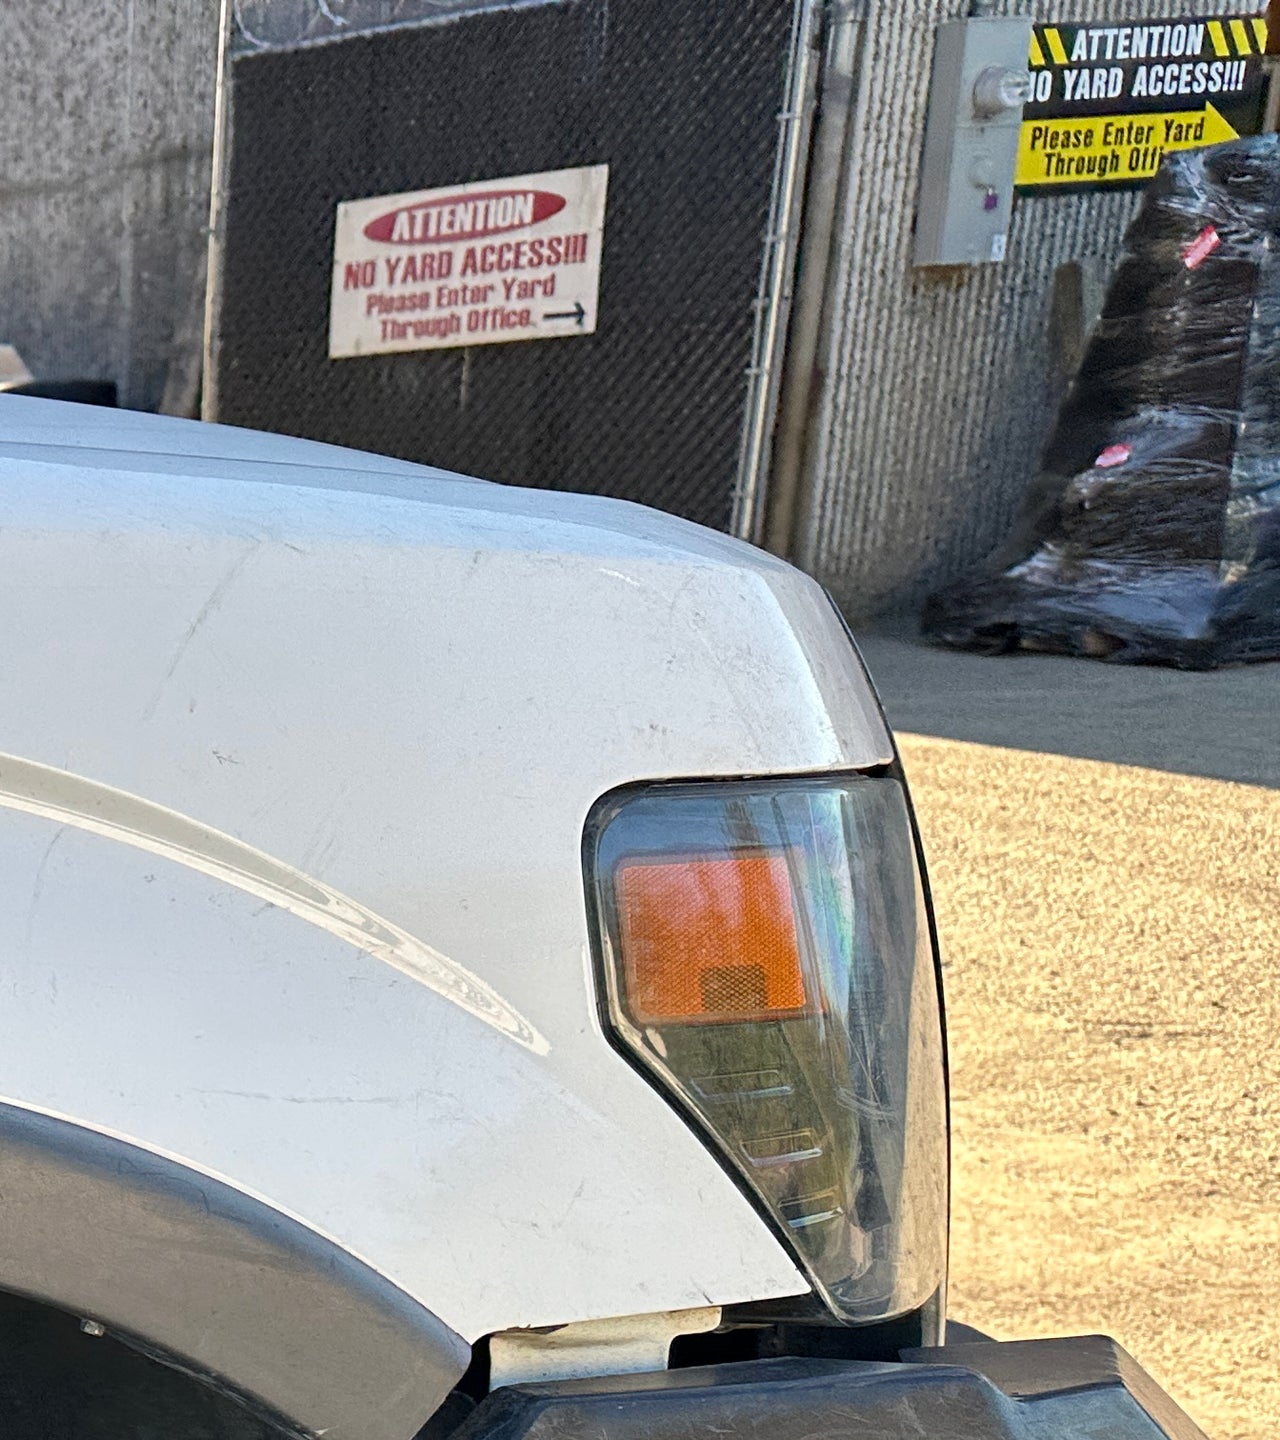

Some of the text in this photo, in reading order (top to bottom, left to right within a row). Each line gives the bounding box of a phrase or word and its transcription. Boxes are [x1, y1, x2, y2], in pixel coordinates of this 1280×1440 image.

[1070, 24, 1205, 62] ATTENTION
[1063, 65, 1124, 100] YARD
[1131, 61, 1246, 97] ACCESS!!!
[1030, 116, 1205, 150] Please Enter Yard
[1044, 145, 1165, 177] Through Offi
[390, 193, 535, 242] ATTENTION
[344, 233, 588, 290] NO YARD ACCESS!!!
[366, 273, 555, 317] Please Enter Yard
[381, 311, 460, 341] Through
